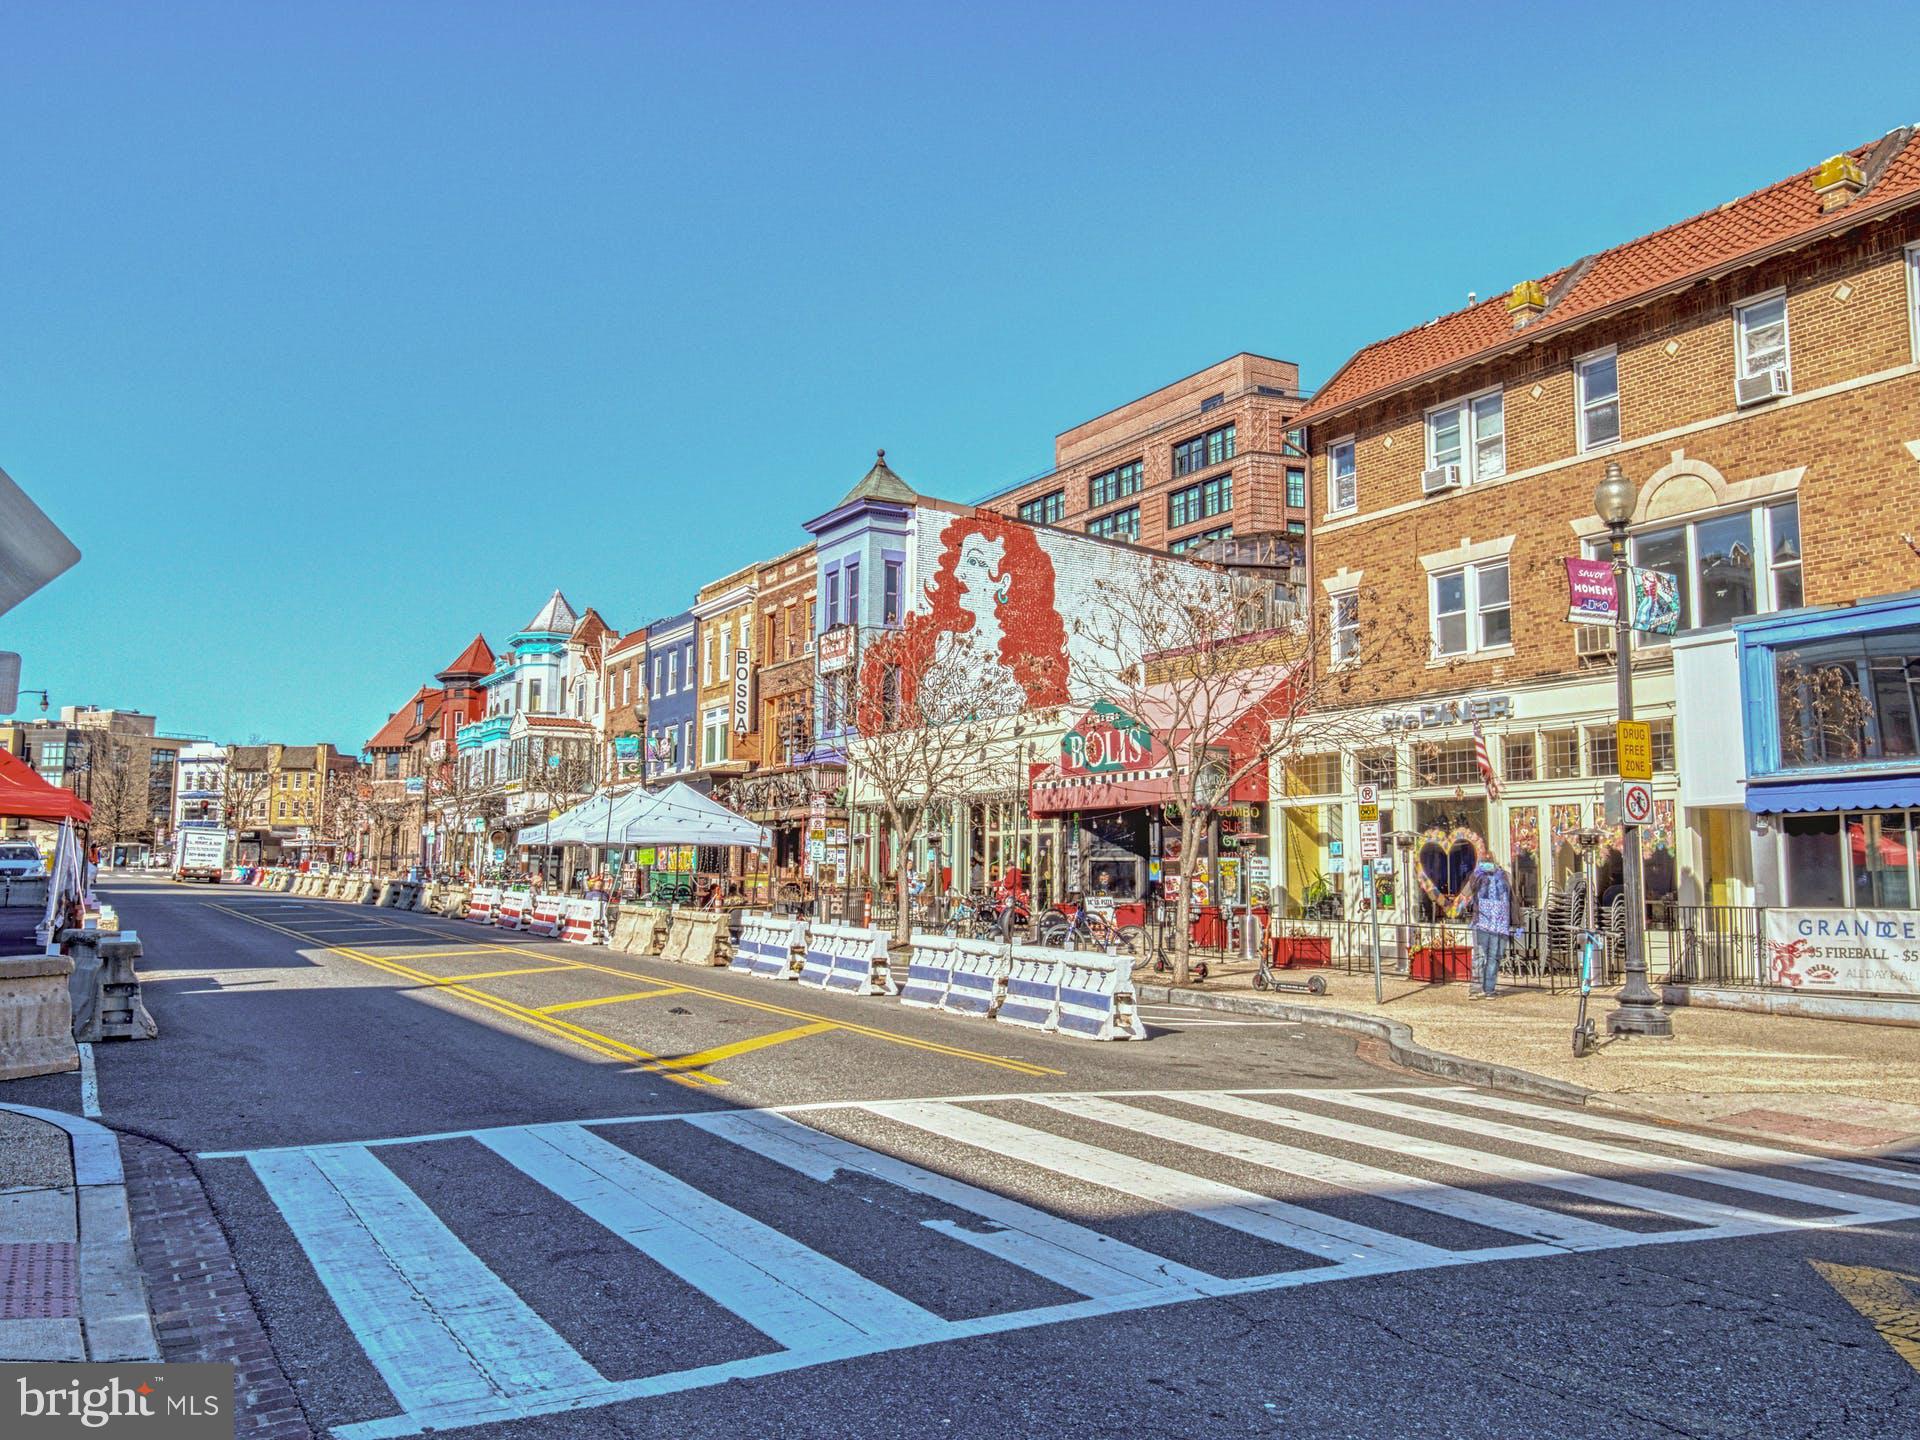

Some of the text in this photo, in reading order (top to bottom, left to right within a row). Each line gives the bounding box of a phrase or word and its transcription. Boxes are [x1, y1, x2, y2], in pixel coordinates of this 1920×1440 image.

[1574, 583, 1614, 596] MOMENT
[736, 650, 748, 731] BOSSA
[1623, 728, 1645, 740] DRUG
[1624, 744, 1645, 756] FREE
[1625, 760, 1645, 772] ZONE
[1218, 807, 1260, 818] JUMBO
[1222, 820, 1249, 833] SLICE
[1825, 947, 1889, 960] FIREBALL
[1865, 969, 1888, 979] DAY
